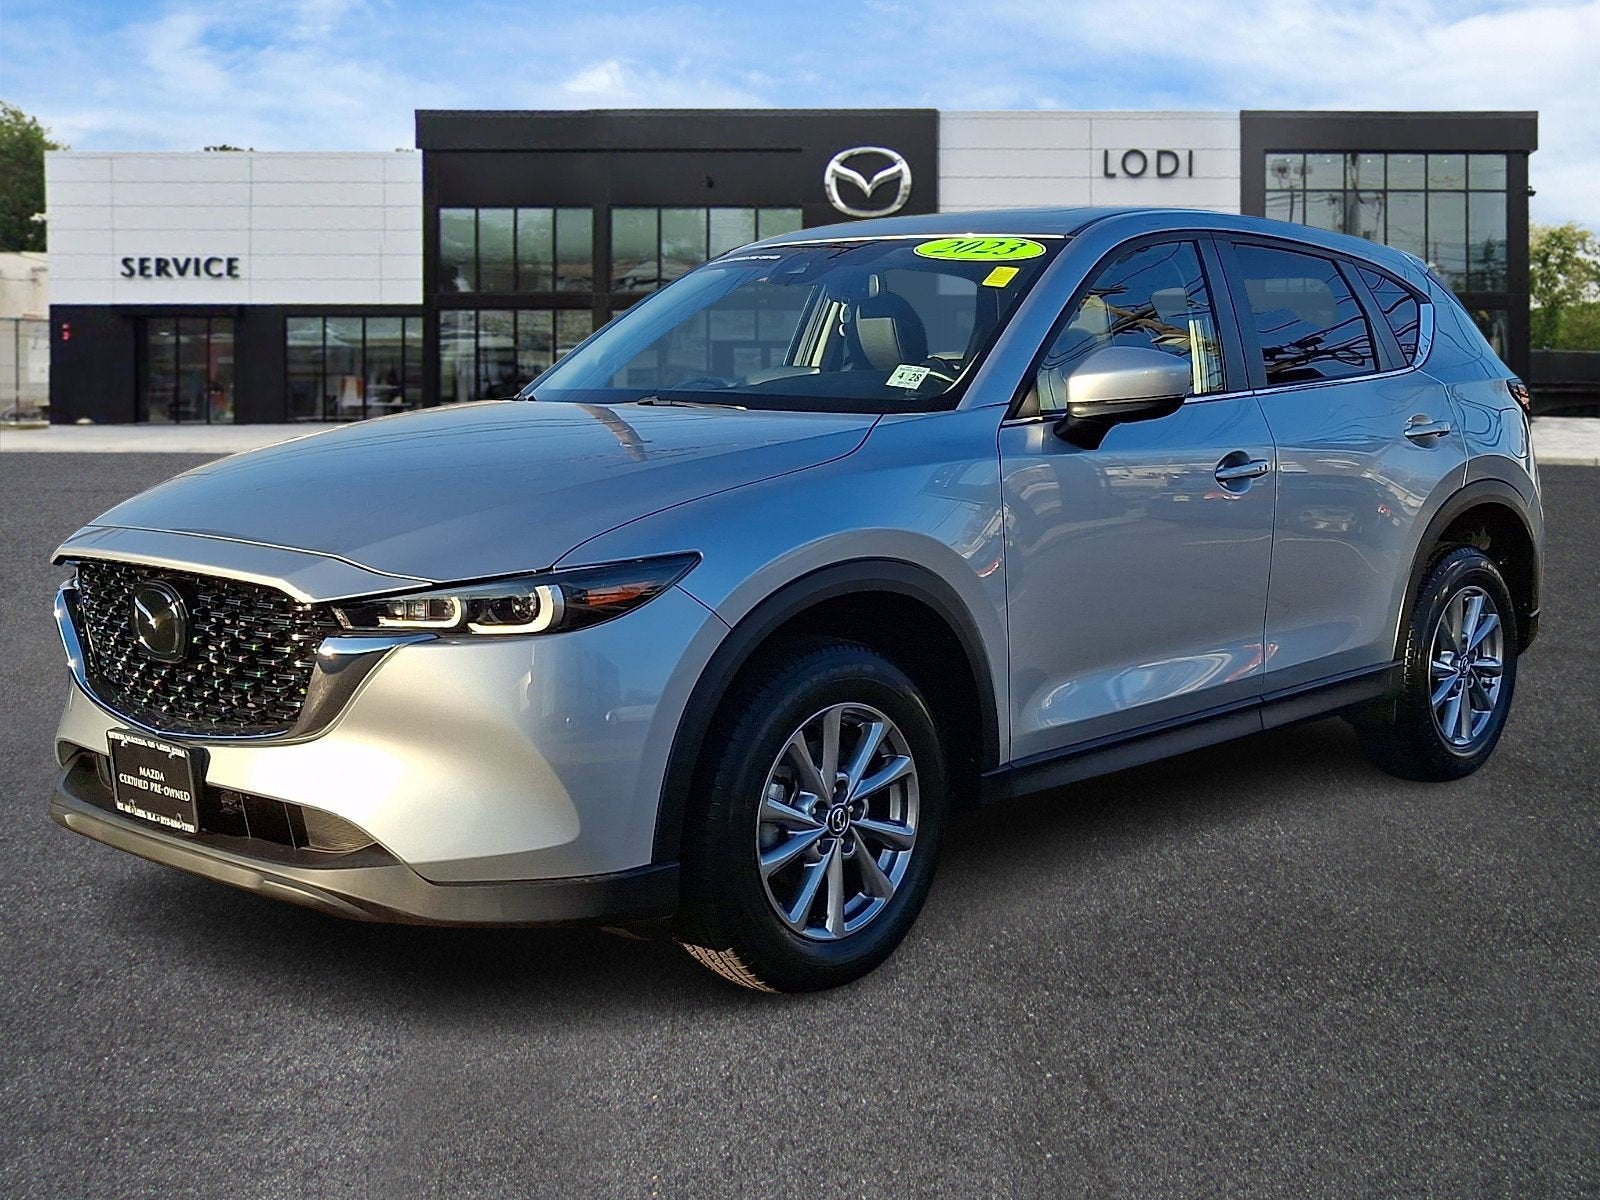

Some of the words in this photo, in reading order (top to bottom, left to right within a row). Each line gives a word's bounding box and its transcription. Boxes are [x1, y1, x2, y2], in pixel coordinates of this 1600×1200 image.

[1103, 148, 1193, 178] LODI
[929, 240, 1028, 255] 2023
[120, 256, 240, 278] SERVICE
[139, 766, 165, 782] MAZDA
[119, 772, 149, 790] CERTIFIED
[150, 782, 191, 801] PRE-OWNED
